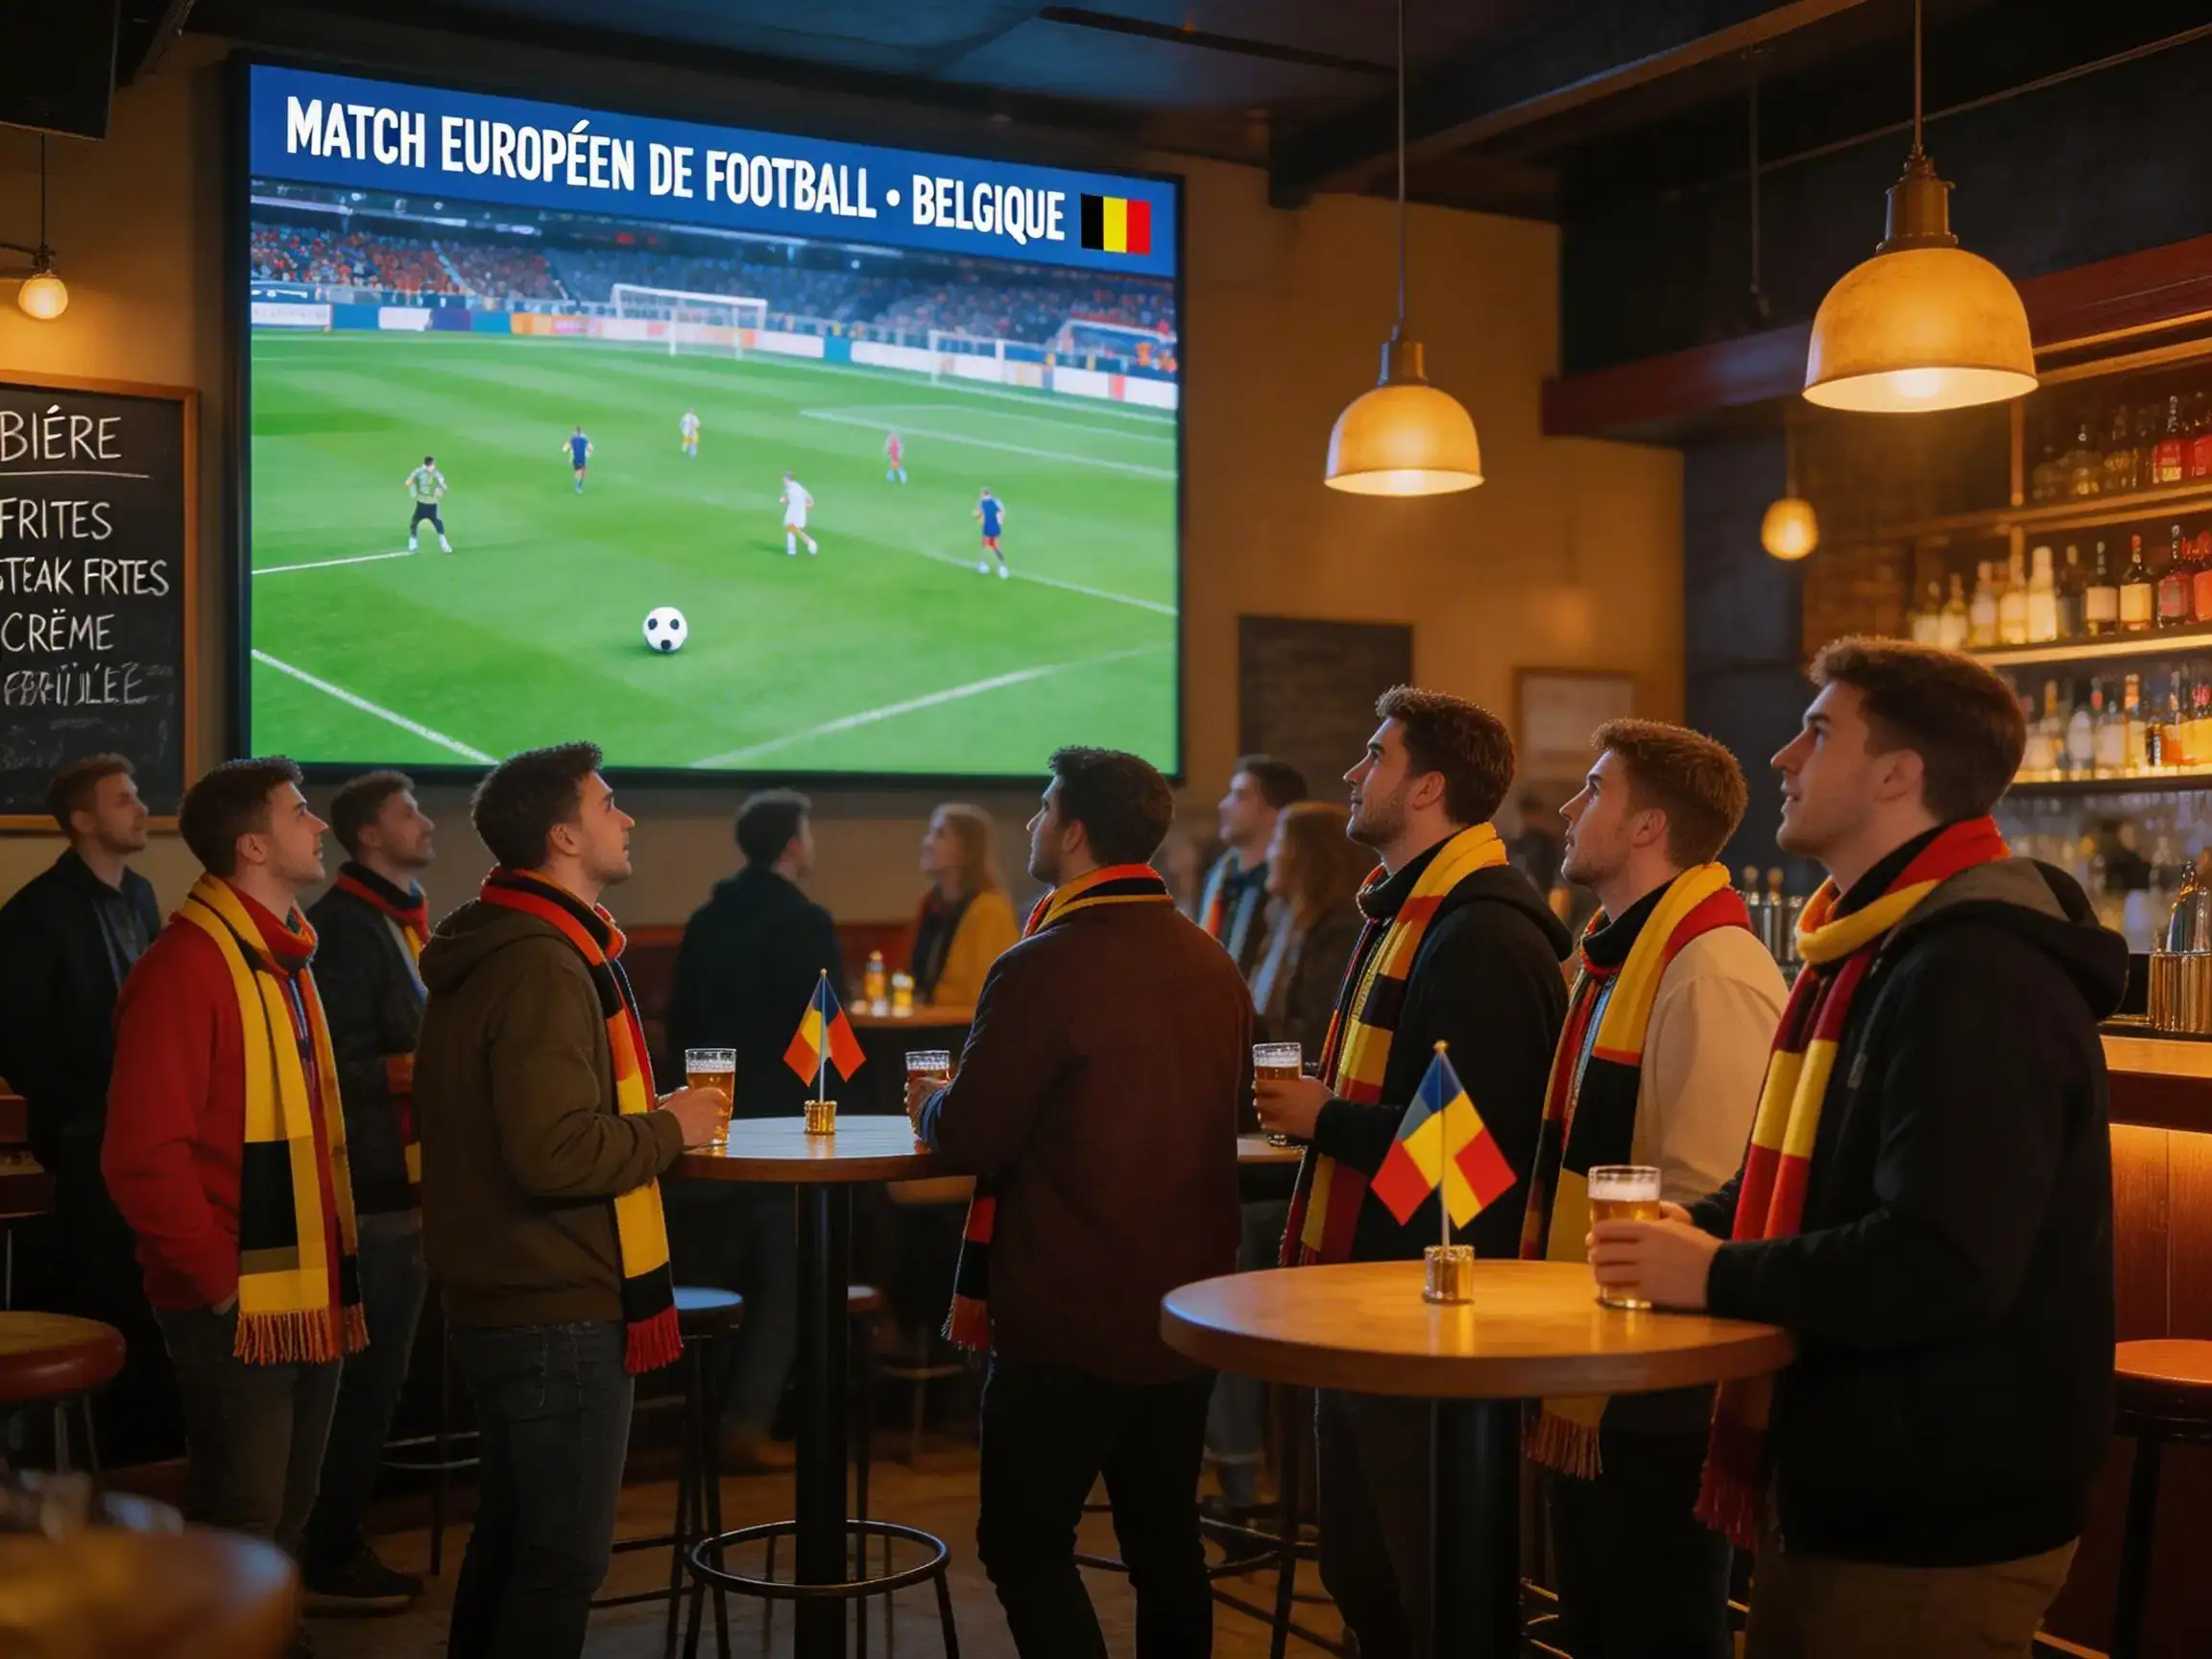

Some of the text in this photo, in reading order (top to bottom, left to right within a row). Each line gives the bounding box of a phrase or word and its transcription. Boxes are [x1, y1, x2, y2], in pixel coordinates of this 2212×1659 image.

[287, 96, 425, 168] MATCH
[442, 115, 635, 191] EUROPÉEN
[649, 143, 694, 198] DE
[706, 150, 877, 219] FOOTBALL
[913, 174, 1066, 245] BELGIQUE
[0, 497, 113, 540] FRITES
[0, 556, 74, 595] TEAK
